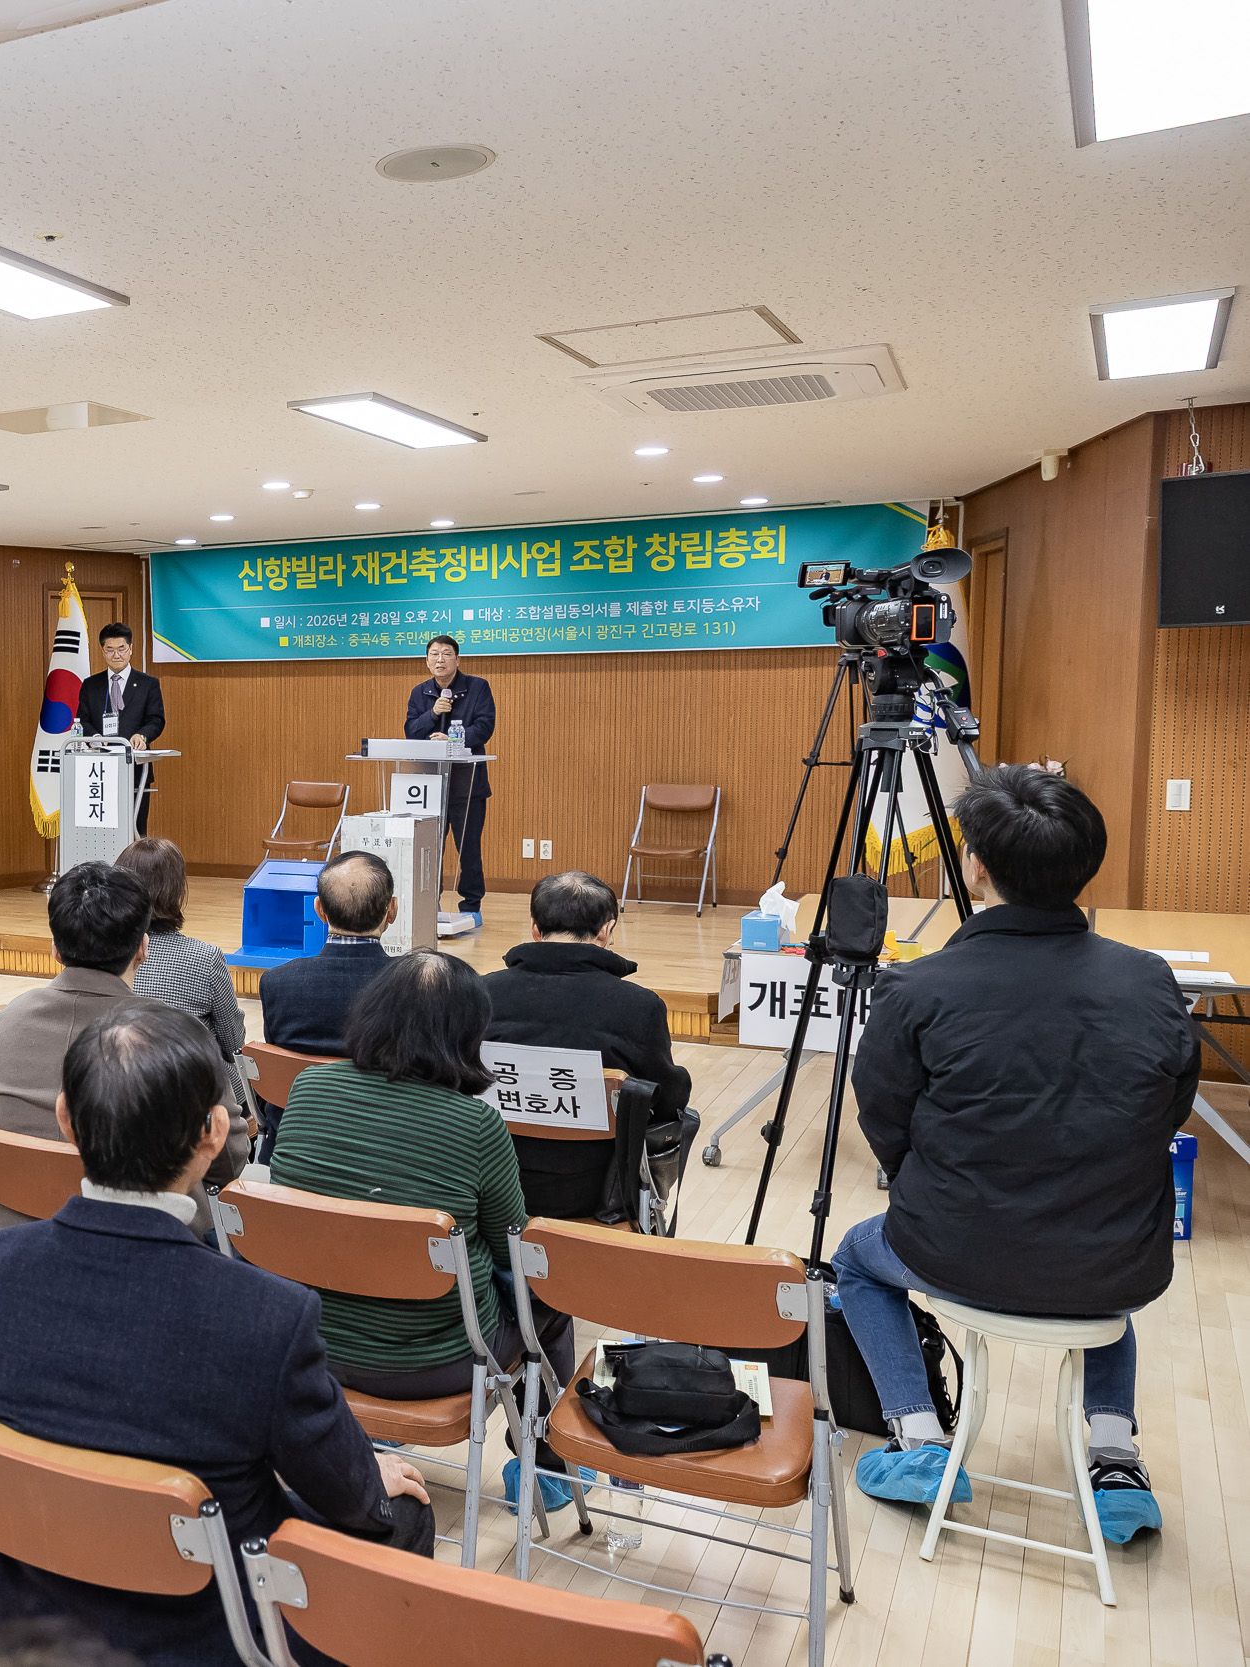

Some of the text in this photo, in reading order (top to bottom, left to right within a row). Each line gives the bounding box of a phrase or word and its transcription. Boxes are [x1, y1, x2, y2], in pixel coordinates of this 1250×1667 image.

[238, 525, 786, 592] 신향빌라 재건축정비사업 조합 창립총회
[274, 615, 296, 629] 일시
[306, 612, 348, 628] 2026년
[351, 611, 369, 627] 2월
[374, 610, 400, 626] 28일
[403, 609, 428, 625] 오후
[432, 608, 452, 624] 2시
[478, 606, 503, 621] 대상
[515, 602, 623, 620] 조합설립동의서를
[626, 600, 667, 617] 제출한
[671, 596, 761, 615] 토지등소유자
[292, 634, 338, 649] 개최장소
[348, 631, 390, 647] 중곡4동
[470, 625, 591, 644] 문화대공연장(서울시
[595, 623, 637, 640] 광진구
[641, 622, 698, 638] 긴고랑로
[703, 620, 736, 636] 131)
[88, 762, 106, 822] 사회자
[405, 784, 428, 809] 의
[548, 1067, 578, 1091] 증
[496, 1088, 581, 1119] 변호사
